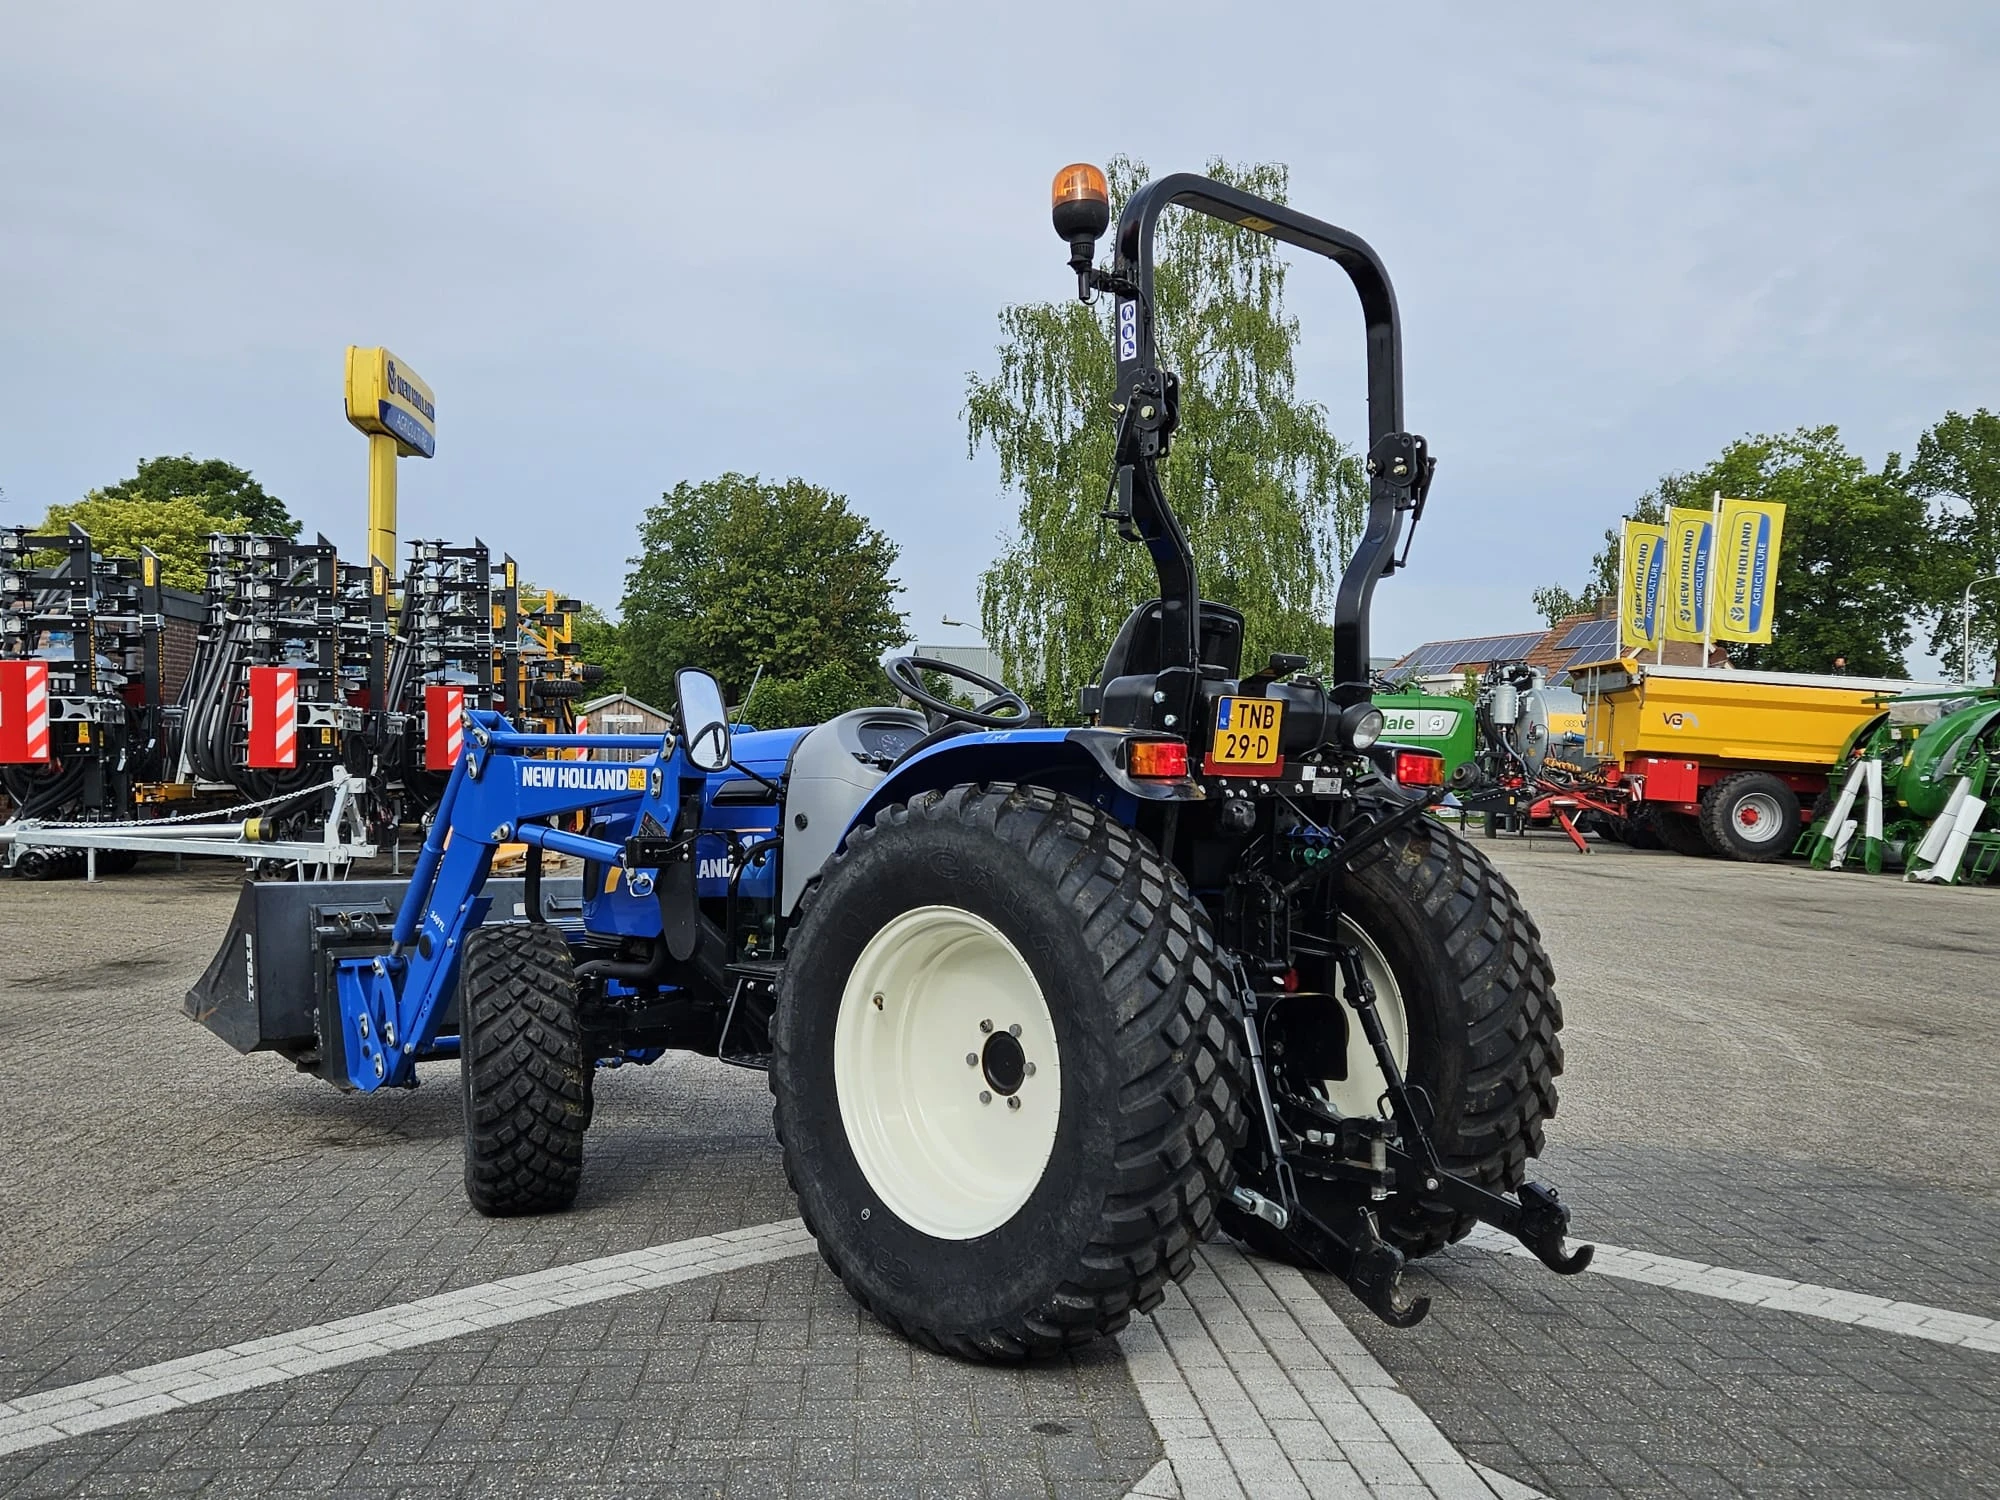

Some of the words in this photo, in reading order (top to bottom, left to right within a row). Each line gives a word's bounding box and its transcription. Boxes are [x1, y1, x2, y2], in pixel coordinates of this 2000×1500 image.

[1635, 543, 1649, 590] HOLLAND
[1681, 529, 1694, 579] HOLLAND
[1738, 522, 1752, 575] HOLLAND
[1646, 562, 1660, 619] AGRICULTURE
[1680, 581, 1690, 606] NEW
[1695, 549, 1707, 608] AGRICULTURE
[1735, 577, 1746, 604] NEW
[1752, 542, 1767, 606] AGRICULTURE
[1220, 717, 1228, 726] NL
[1239, 704, 1274, 729] TNB
[522, 766, 556, 788] NEW
[557, 767, 628, 791] HOLLAND
[697, 858, 734, 879] AND
[245, 933, 255, 1003] STOLL
